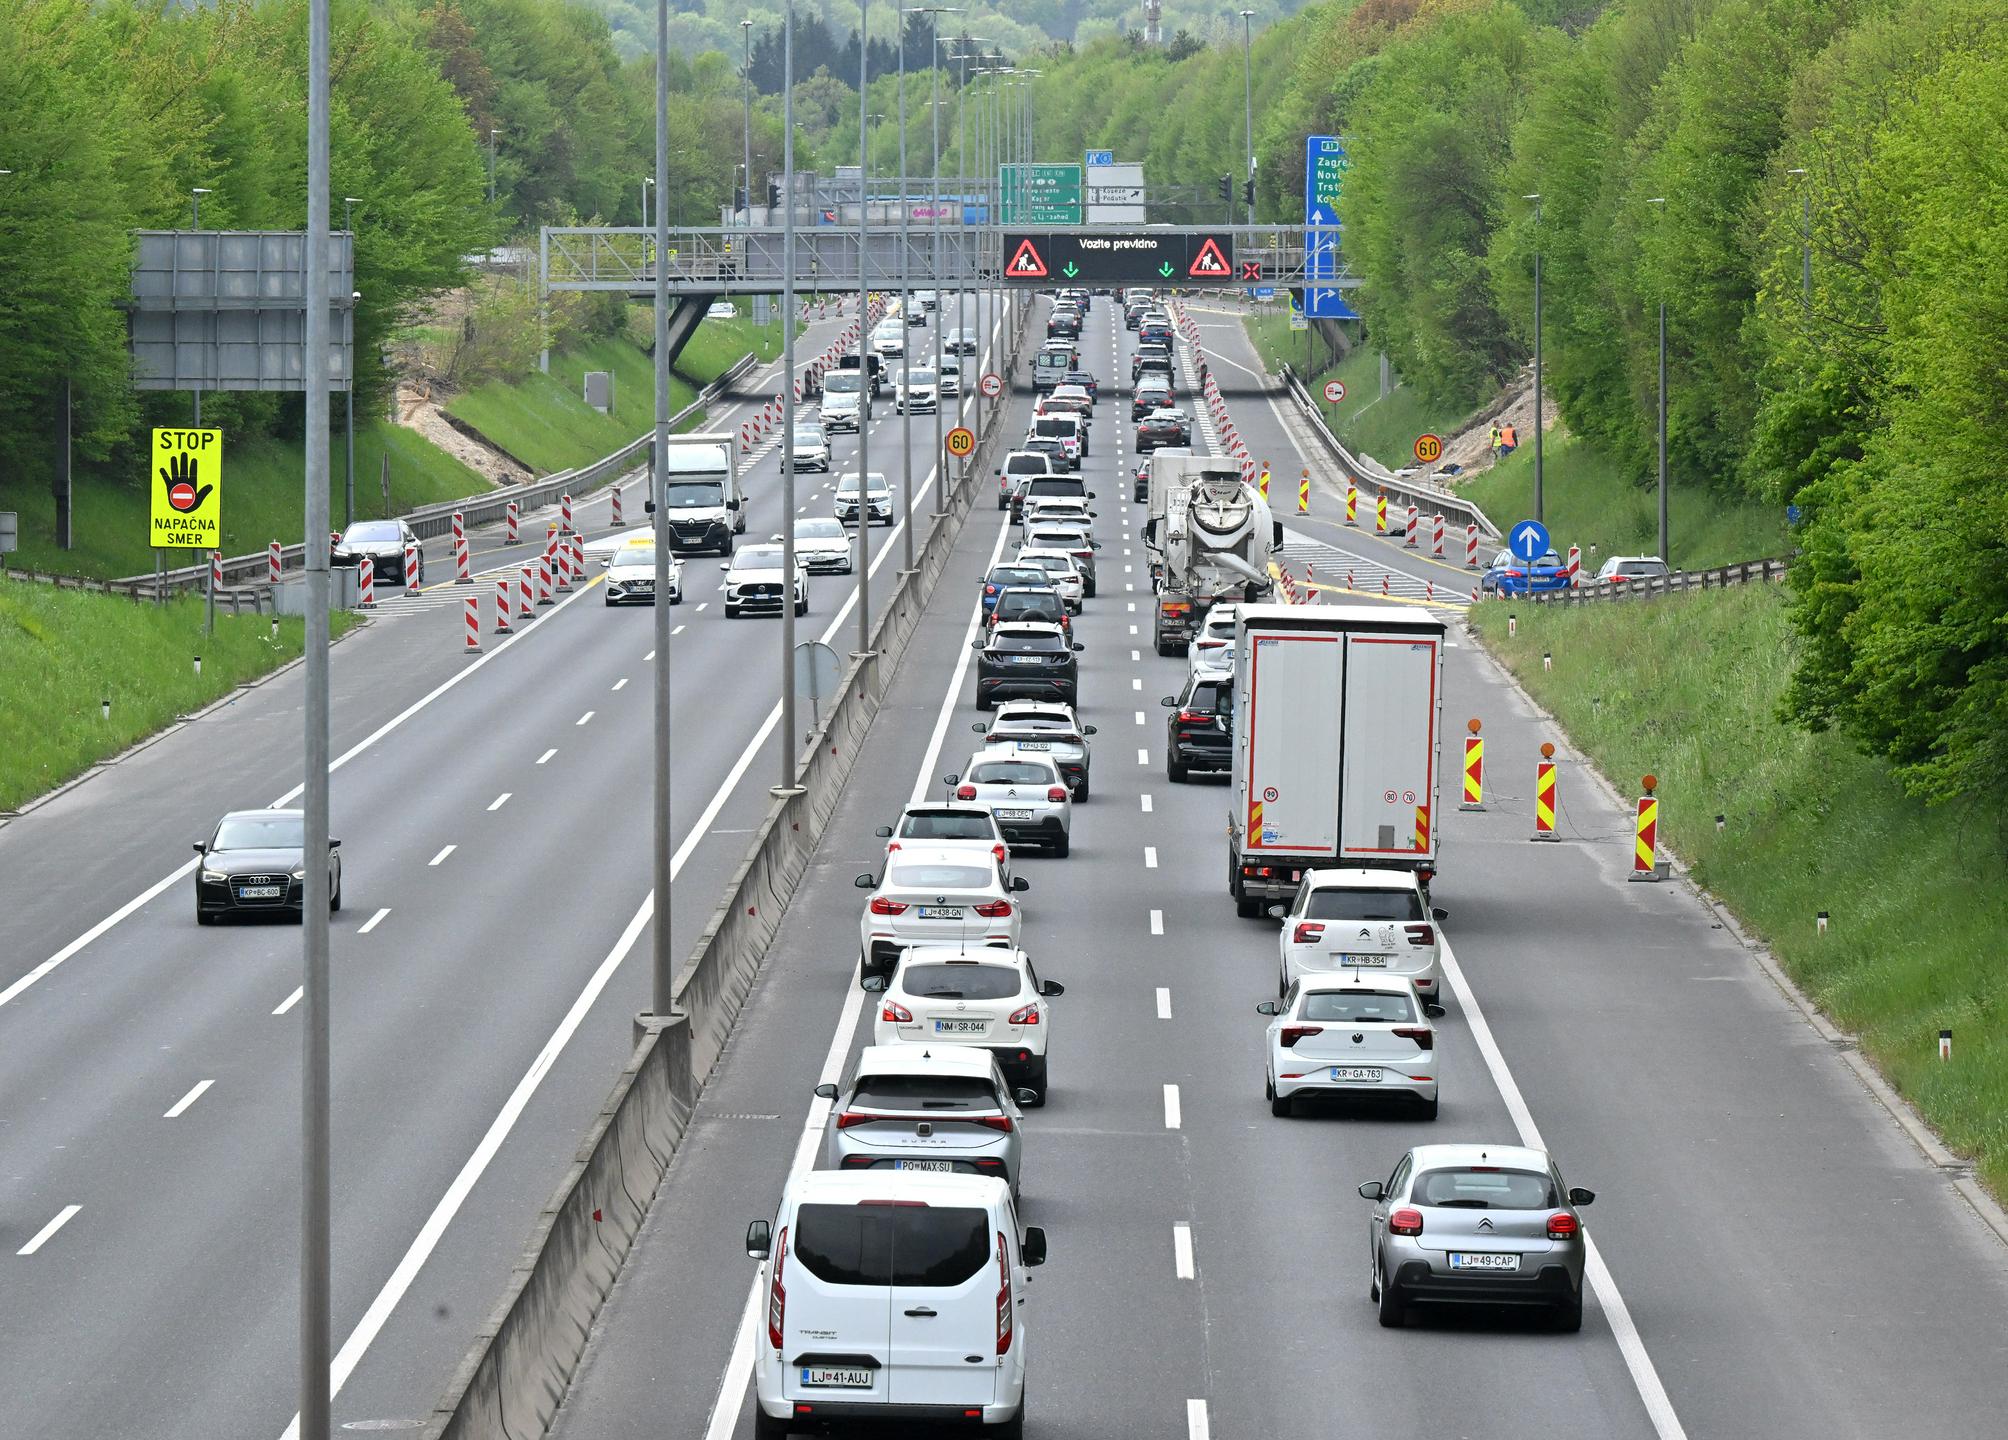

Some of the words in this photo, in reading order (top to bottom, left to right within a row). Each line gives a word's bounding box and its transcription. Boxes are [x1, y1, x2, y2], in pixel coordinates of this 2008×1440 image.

[1079, 239, 1111, 249] Vozite
[1113, 239, 1158, 251] previdno
[160, 431, 214, 450] STOP
[952, 435, 969, 450] 60
[1419, 441, 1437, 456] 60
[155, 516, 216, 531] NAPAČNA
[167, 533, 203, 545] SMER
[1266, 790, 1275, 798] 90
[1386, 793, 1395, 801] 80
[1405, 793, 1413, 802] 70
[937, 908, 962, 917] 438-GN
[1361, 955, 1385, 965] HB-354
[959, 1022, 985, 1031] SR-044
[1352, 1069, 1381, 1079] GA-763
[920, 1162, 950, 1172] MAX-SU
[1461, 1255, 1474, 1266] LJ
[1479, 1255, 1514, 1266] 49-CAP
[811, 1370, 826, 1383] LJ
[832, 1371, 869, 1384] 41-AUJ
